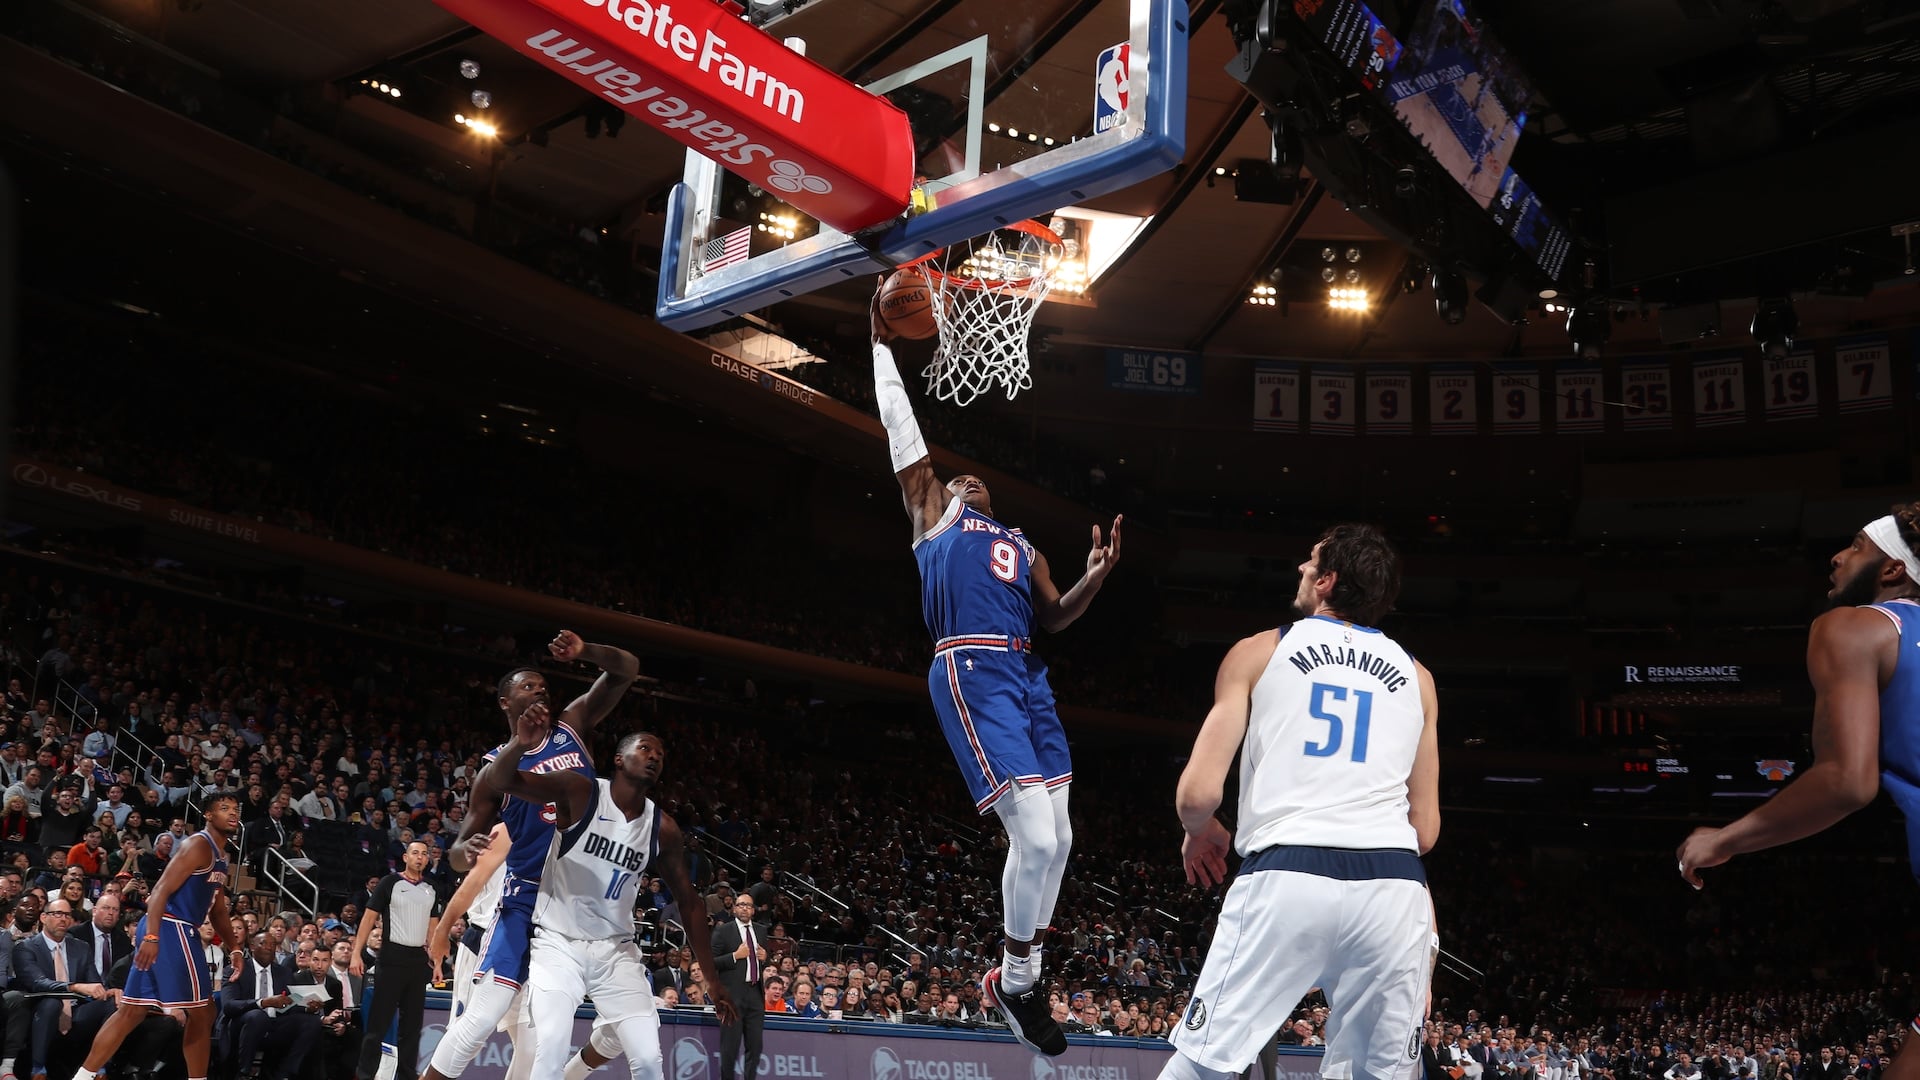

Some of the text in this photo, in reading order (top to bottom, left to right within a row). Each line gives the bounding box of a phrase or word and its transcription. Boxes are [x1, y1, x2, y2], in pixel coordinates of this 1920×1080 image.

[590, 0, 805, 123] tateFarm
[1123, 353, 1150, 368] BILLY
[1124, 368, 1148, 383] JOEL
[1152, 356, 1187, 386] 69
[711, 353, 815, 406] CHASE BRIDGE
[1771, 371, 1809, 405] 19
[1851, 363, 1874, 396] 7
[1270, 388, 1283, 417] 1
[1324, 390, 1341, 420] 3
[1379, 390, 1398, 419] 9
[1444, 390, 1463, 419] 2
[1507, 389, 1525, 419] 9
[1565, 388, 1595, 418] 11
[1625, 384, 1667, 415] 35
[1704, 379, 1735, 411] 11
[51, 476, 144, 512] LEXUS
[168, 508, 261, 543] SUITE LEVEL
[962, 518, 1001, 535] NEW
[990, 539, 1019, 583] 9
[1624, 665, 1644, 683] R
[1647, 666, 1737, 677] RENAISSANCE
[1303, 682, 1373, 763] 51
[544, 752, 584, 772] YORK
[583, 832, 645, 872] DALLAS
[604, 868, 632, 900] 10
[775, 1054, 824, 1077] BELL
[904, 1059, 992, 1080] TACO BELL
[1058, 1065, 1095, 1080] TACO
